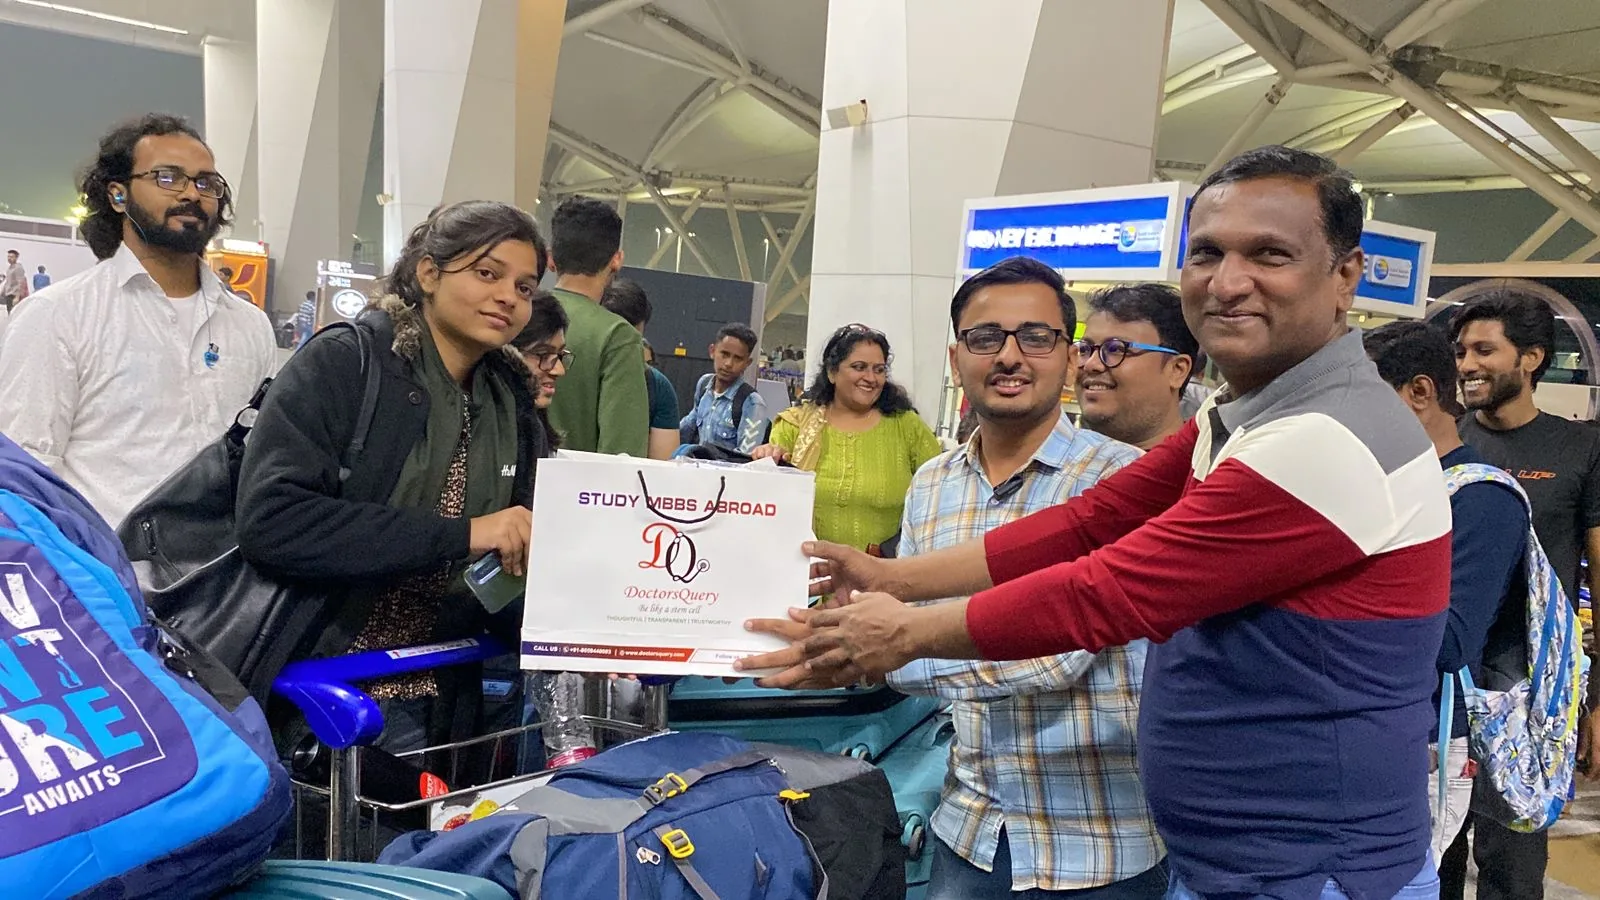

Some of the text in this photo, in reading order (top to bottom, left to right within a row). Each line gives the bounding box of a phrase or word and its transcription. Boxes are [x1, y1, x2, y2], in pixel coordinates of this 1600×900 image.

[578, 492, 777, 517] STUDY MBBS ABROAD
[623, 585, 720, 606] DoctorsQuery
[638, 604, 649, 613] Be
[650, 604, 664, 614] like
[670, 606, 687, 614] stem
[688, 605, 702, 615] cell
[23, 764, 122, 816] AWAITS
